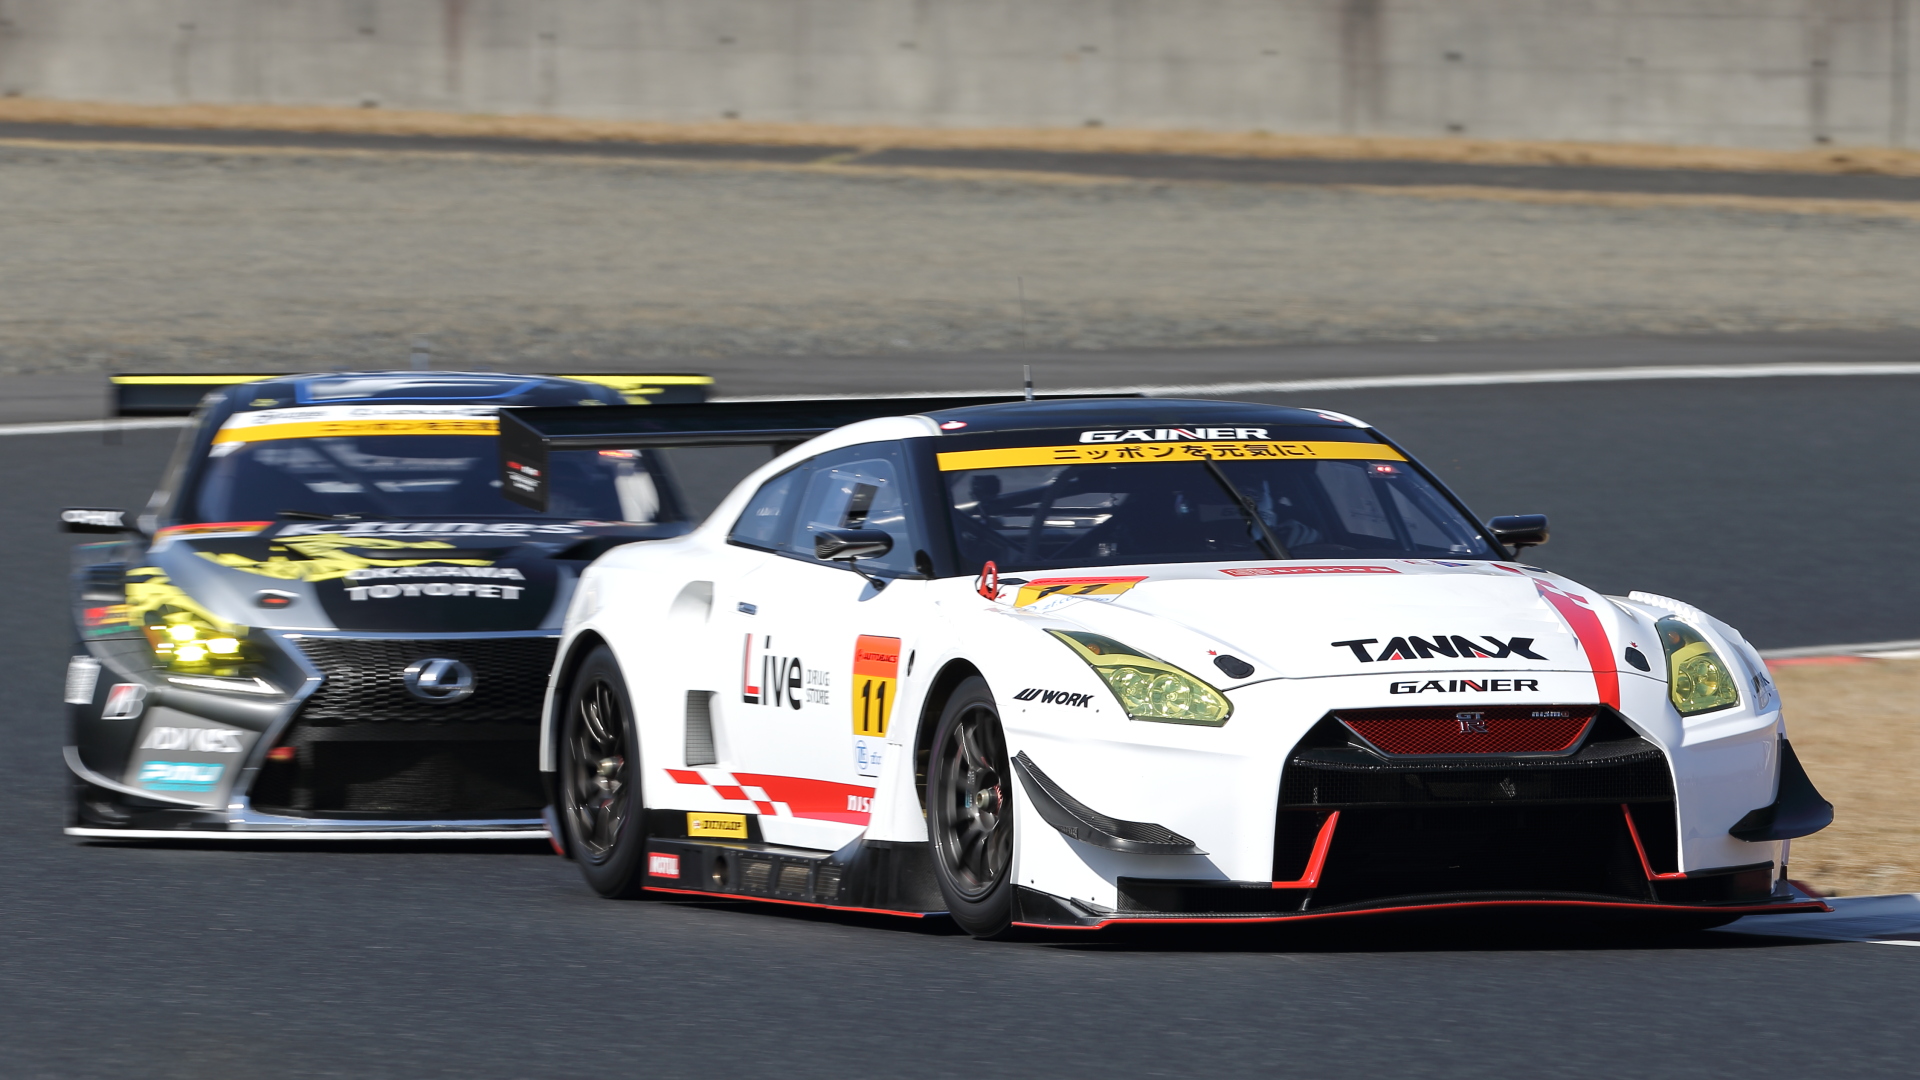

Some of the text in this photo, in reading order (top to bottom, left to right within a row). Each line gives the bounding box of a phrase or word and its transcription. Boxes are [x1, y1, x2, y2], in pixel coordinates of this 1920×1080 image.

[1079, 427, 1271, 443] GAINER
[344, 583, 526, 601] TOYOPET
[1330, 635, 1550, 663] TANAX
[743, 633, 802, 710] Live
[806, 669, 830, 686] DRUG
[1389, 679, 1540, 694] GAINER
[806, 688, 830, 705] STORE
[1041, 689, 1096, 708] WORK
[861, 679, 887, 733] 11
